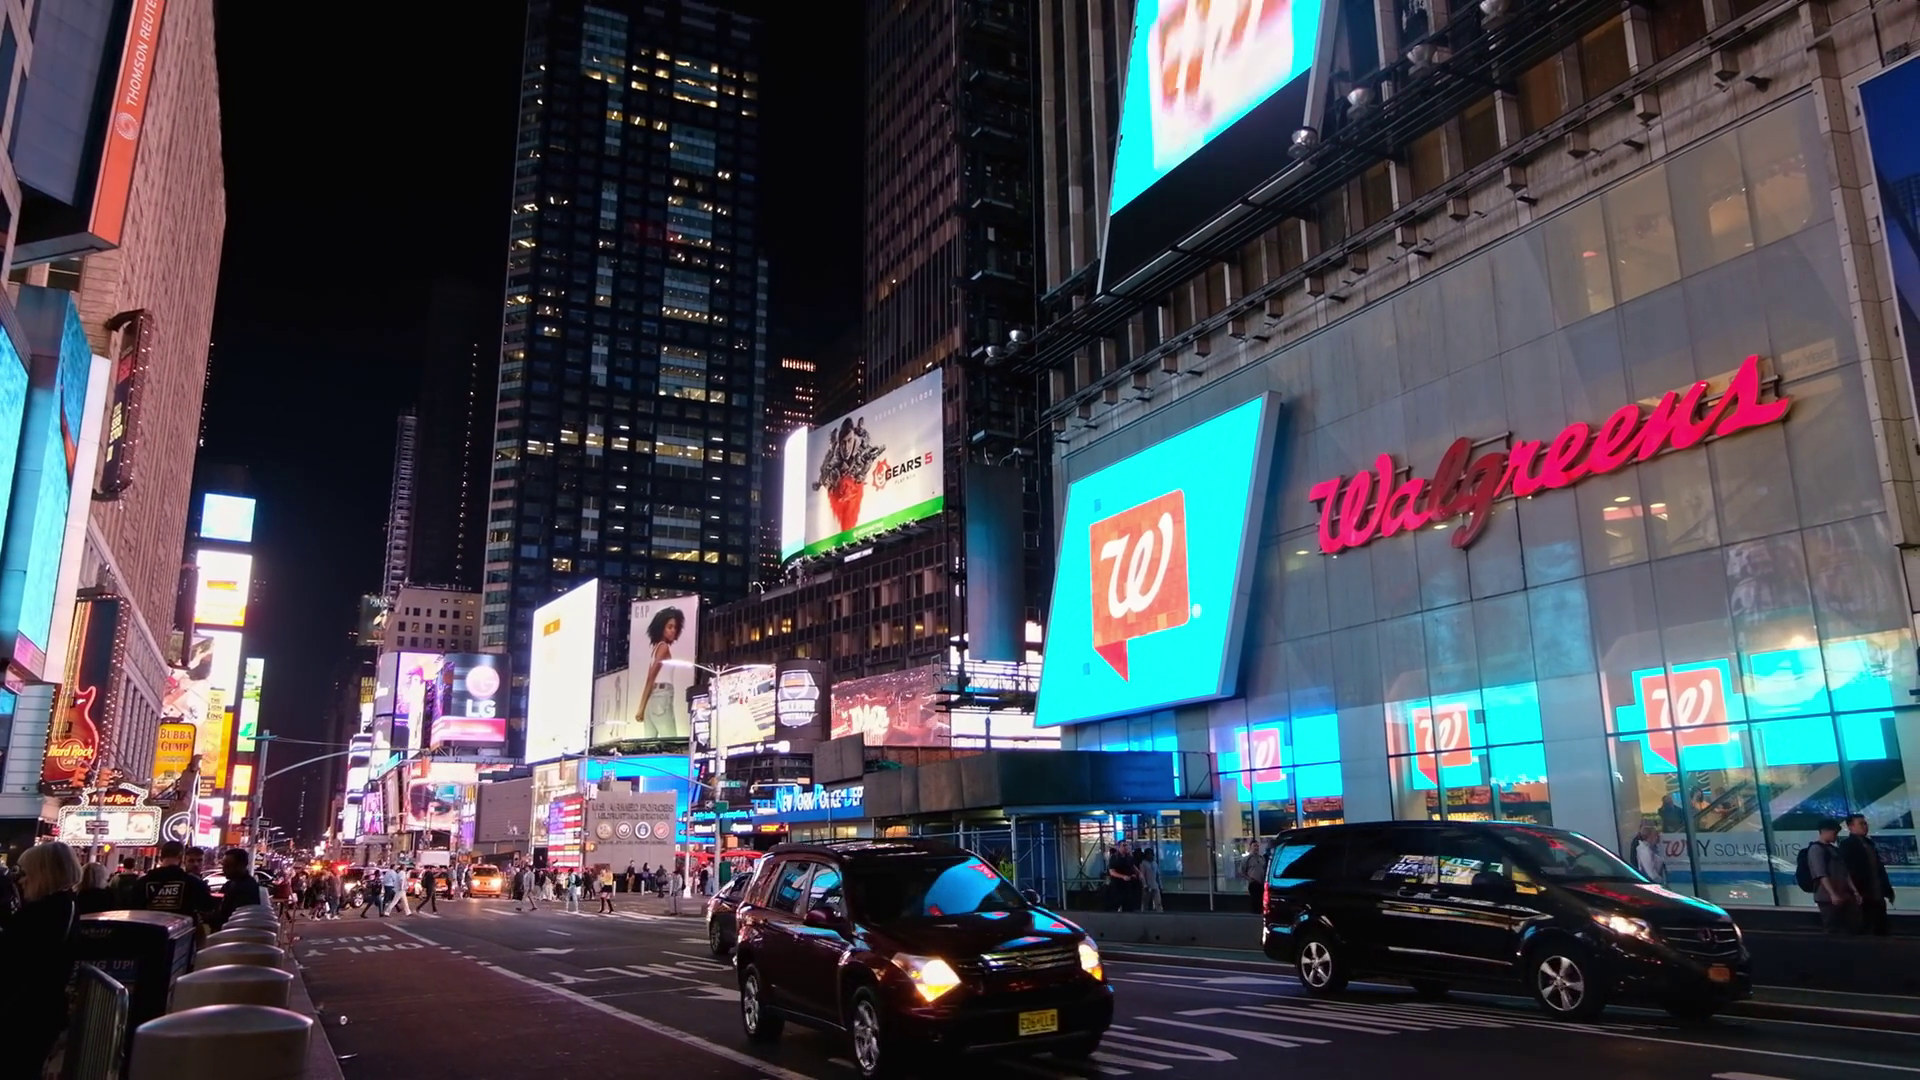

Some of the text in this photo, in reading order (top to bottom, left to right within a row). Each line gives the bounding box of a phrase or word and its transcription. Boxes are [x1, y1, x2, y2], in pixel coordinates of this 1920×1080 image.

[126, 0, 158, 107] THOMSON REUTE
[1309, 354, 1790, 555] Walgreens
[884, 451, 933, 481] GEARS 5
[634, 605, 650, 619] GAP
[465, 698, 497, 719] LG
[160, 728, 192, 740] BUBBA
[47, 743, 94, 759] Hard Rock
[160, 741, 189, 752] GUMP
[114, 793, 136, 805] Rock
[776, 786, 794, 813] NEW
[607, 803, 639, 812] ARMED
[640, 803, 674, 813] FORCES
[303, 942, 424, 957] ONLY
